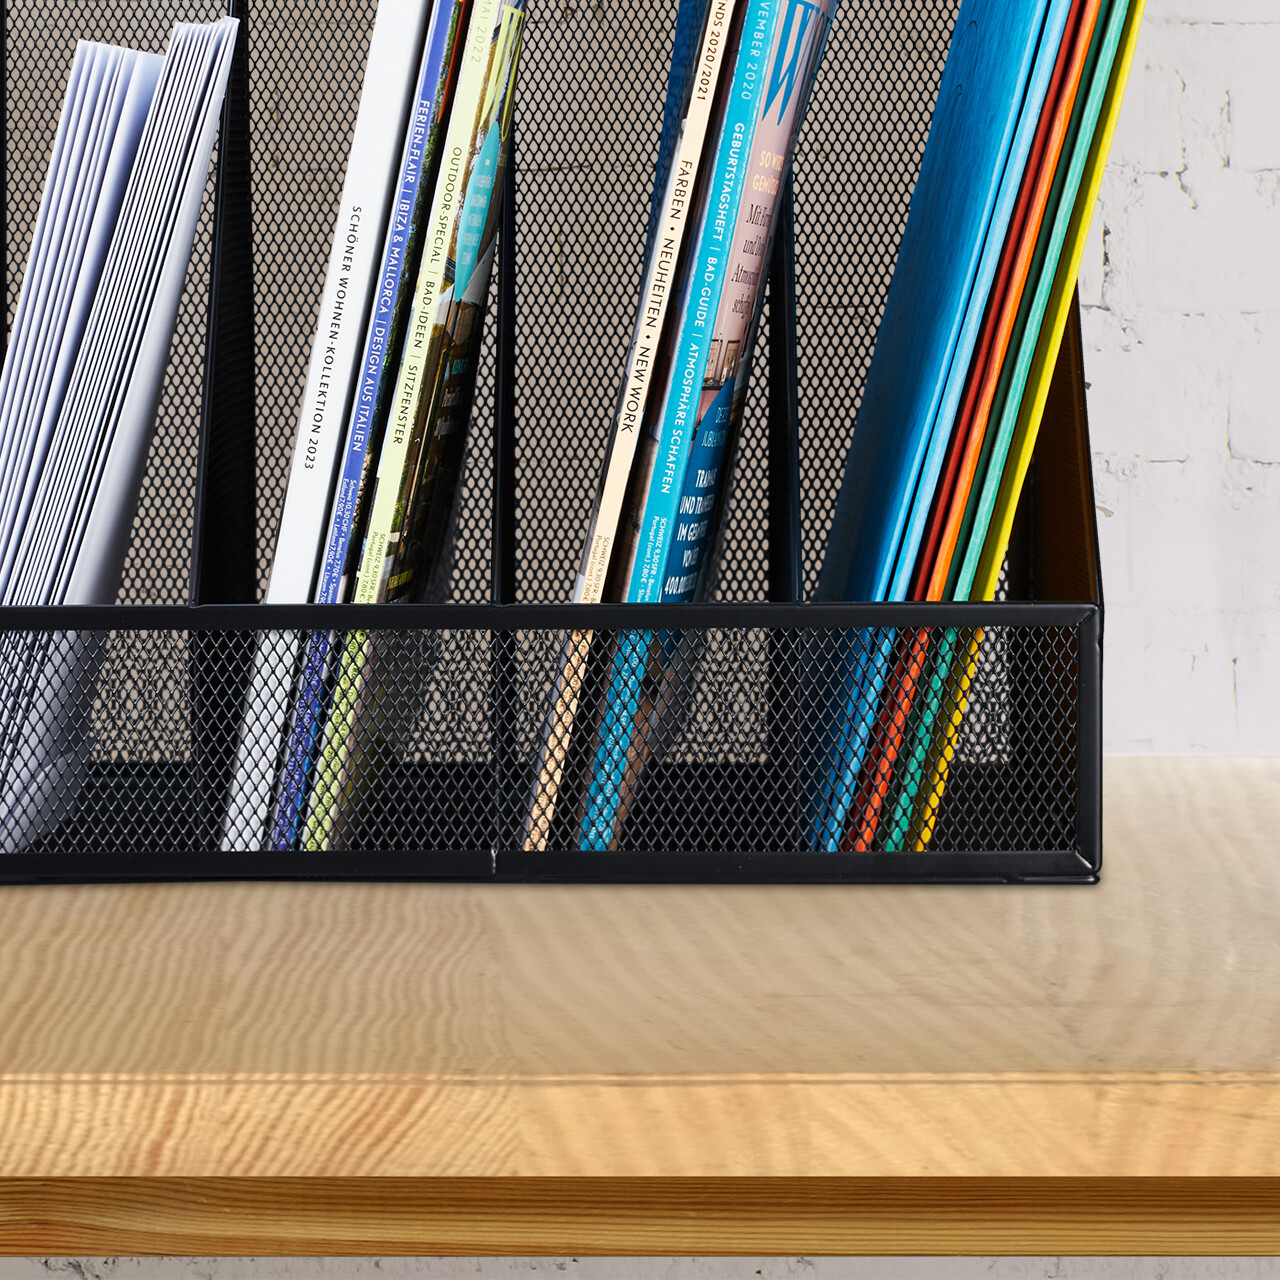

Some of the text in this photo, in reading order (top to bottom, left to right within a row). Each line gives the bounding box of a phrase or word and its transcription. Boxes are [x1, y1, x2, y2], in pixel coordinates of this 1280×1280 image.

[471, 25, 487, 63] 2022
[697, 30, 720, 101] 2020/2021
[741, 62, 758, 101] 2020
[404, 101, 430, 183] FERIEN-FLAIR
[395, 199, 409, 231] IBIZA
[712, 123, 745, 241] GEBURTSTAGSHEFT
[379, 247, 400, 313] MALLORCA
[393, 147, 462, 444] OUTDOOR-SPECIAL BAD-IDEEN SITZFENSTER
[621, 159, 692, 433] FARBEN NEUHEITEN NEW WORK
[695, 257, 718, 327] BAD-GUIDE
[304, 206, 361, 470] SCHÖNER WOHNEN-KOLLEKTION 2023
[366, 327, 385, 375] DESIGN
[357, 378, 378, 402] AUS
[675, 343, 700, 428] ATMOSPHÄRE
[353, 405, 369, 452] ITALIEN
[661, 429, 682, 493] SCHAFFEN
